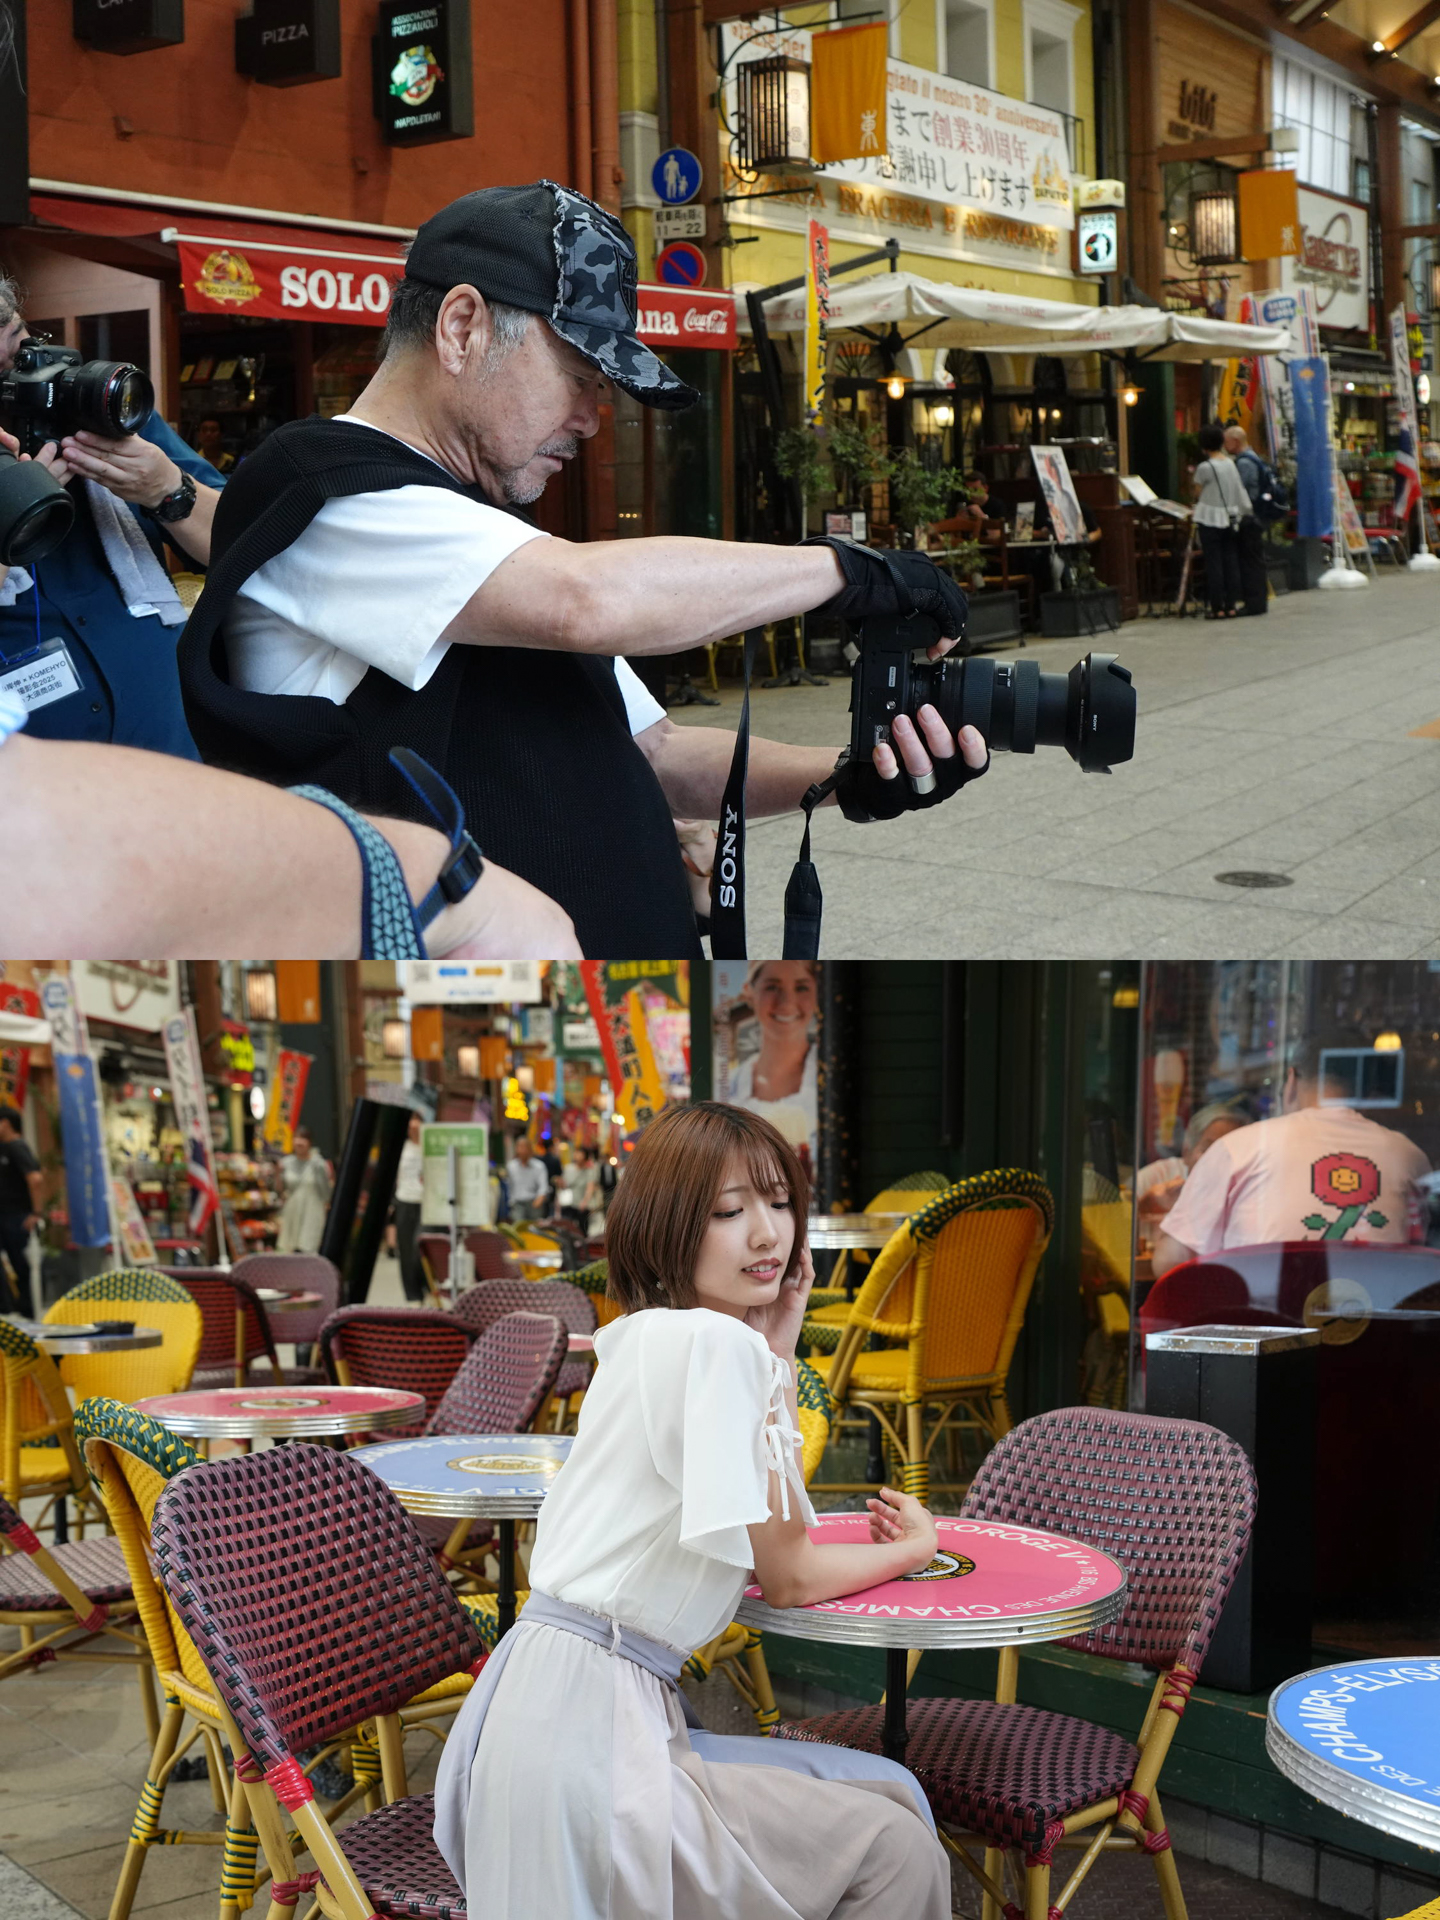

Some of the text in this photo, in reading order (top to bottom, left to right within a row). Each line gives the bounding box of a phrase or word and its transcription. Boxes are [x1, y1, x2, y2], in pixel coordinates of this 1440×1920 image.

[262, 23, 309, 45] PIZZA
[205, 286, 251, 296] SOLO PIZZA
[279, 265, 391, 314] SOLO
[46, 382, 54, 409] Canon
[28, 660, 67, 681] KOMEHYO
[17, 674, 56, 695] 撮影会2025
[26, 680, 63, 702] 大須商店街
[719, 803, 738, 909] SONY
[934, 1520, 1071, 1552] EOROGE
[1079, 1565, 1099, 1576] 116
[1004, 1599, 1045, 1610] DES
[1049, 1584, 1091, 1605] AVENUE
[1369, 1764, 1428, 1788] DES
